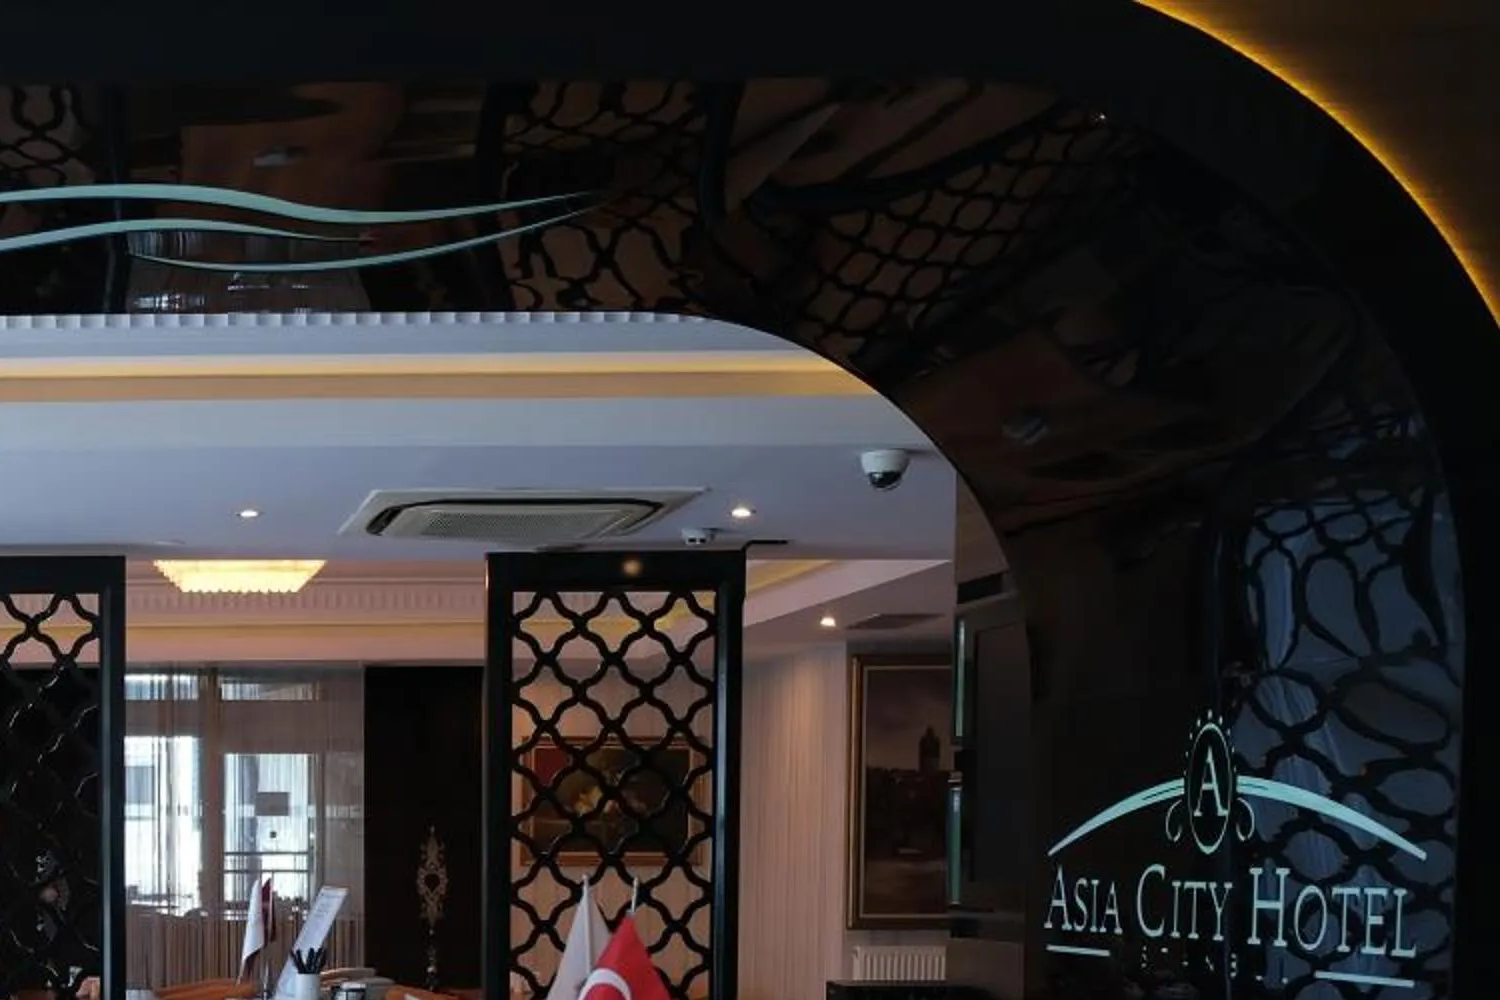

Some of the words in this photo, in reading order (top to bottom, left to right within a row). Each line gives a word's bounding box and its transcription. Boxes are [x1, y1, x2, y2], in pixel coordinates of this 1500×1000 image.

[1043, 864, 1124, 935] ASIA
[1136, 863, 1234, 942] CITY
[1246, 866, 1418, 959] HOTEL
